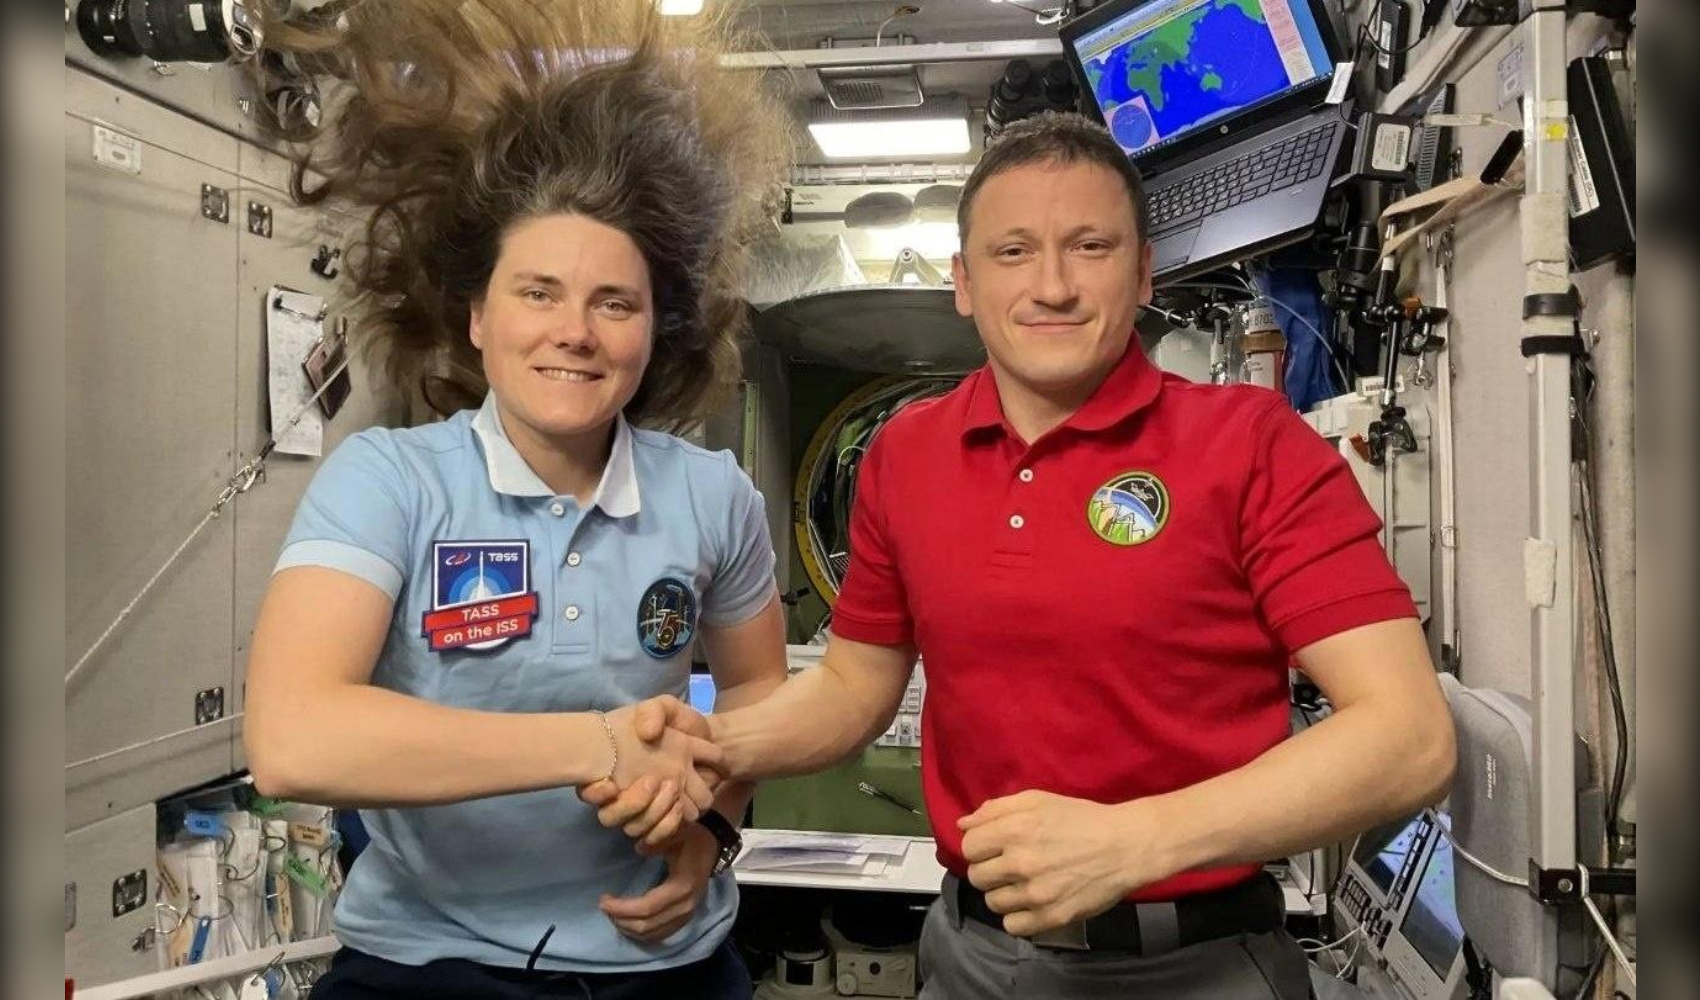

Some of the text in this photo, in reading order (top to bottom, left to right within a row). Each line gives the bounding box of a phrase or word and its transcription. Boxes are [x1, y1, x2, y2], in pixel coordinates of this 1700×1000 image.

[461, 604, 500, 622] TASS
[443, 619, 519, 644] on the ISS
